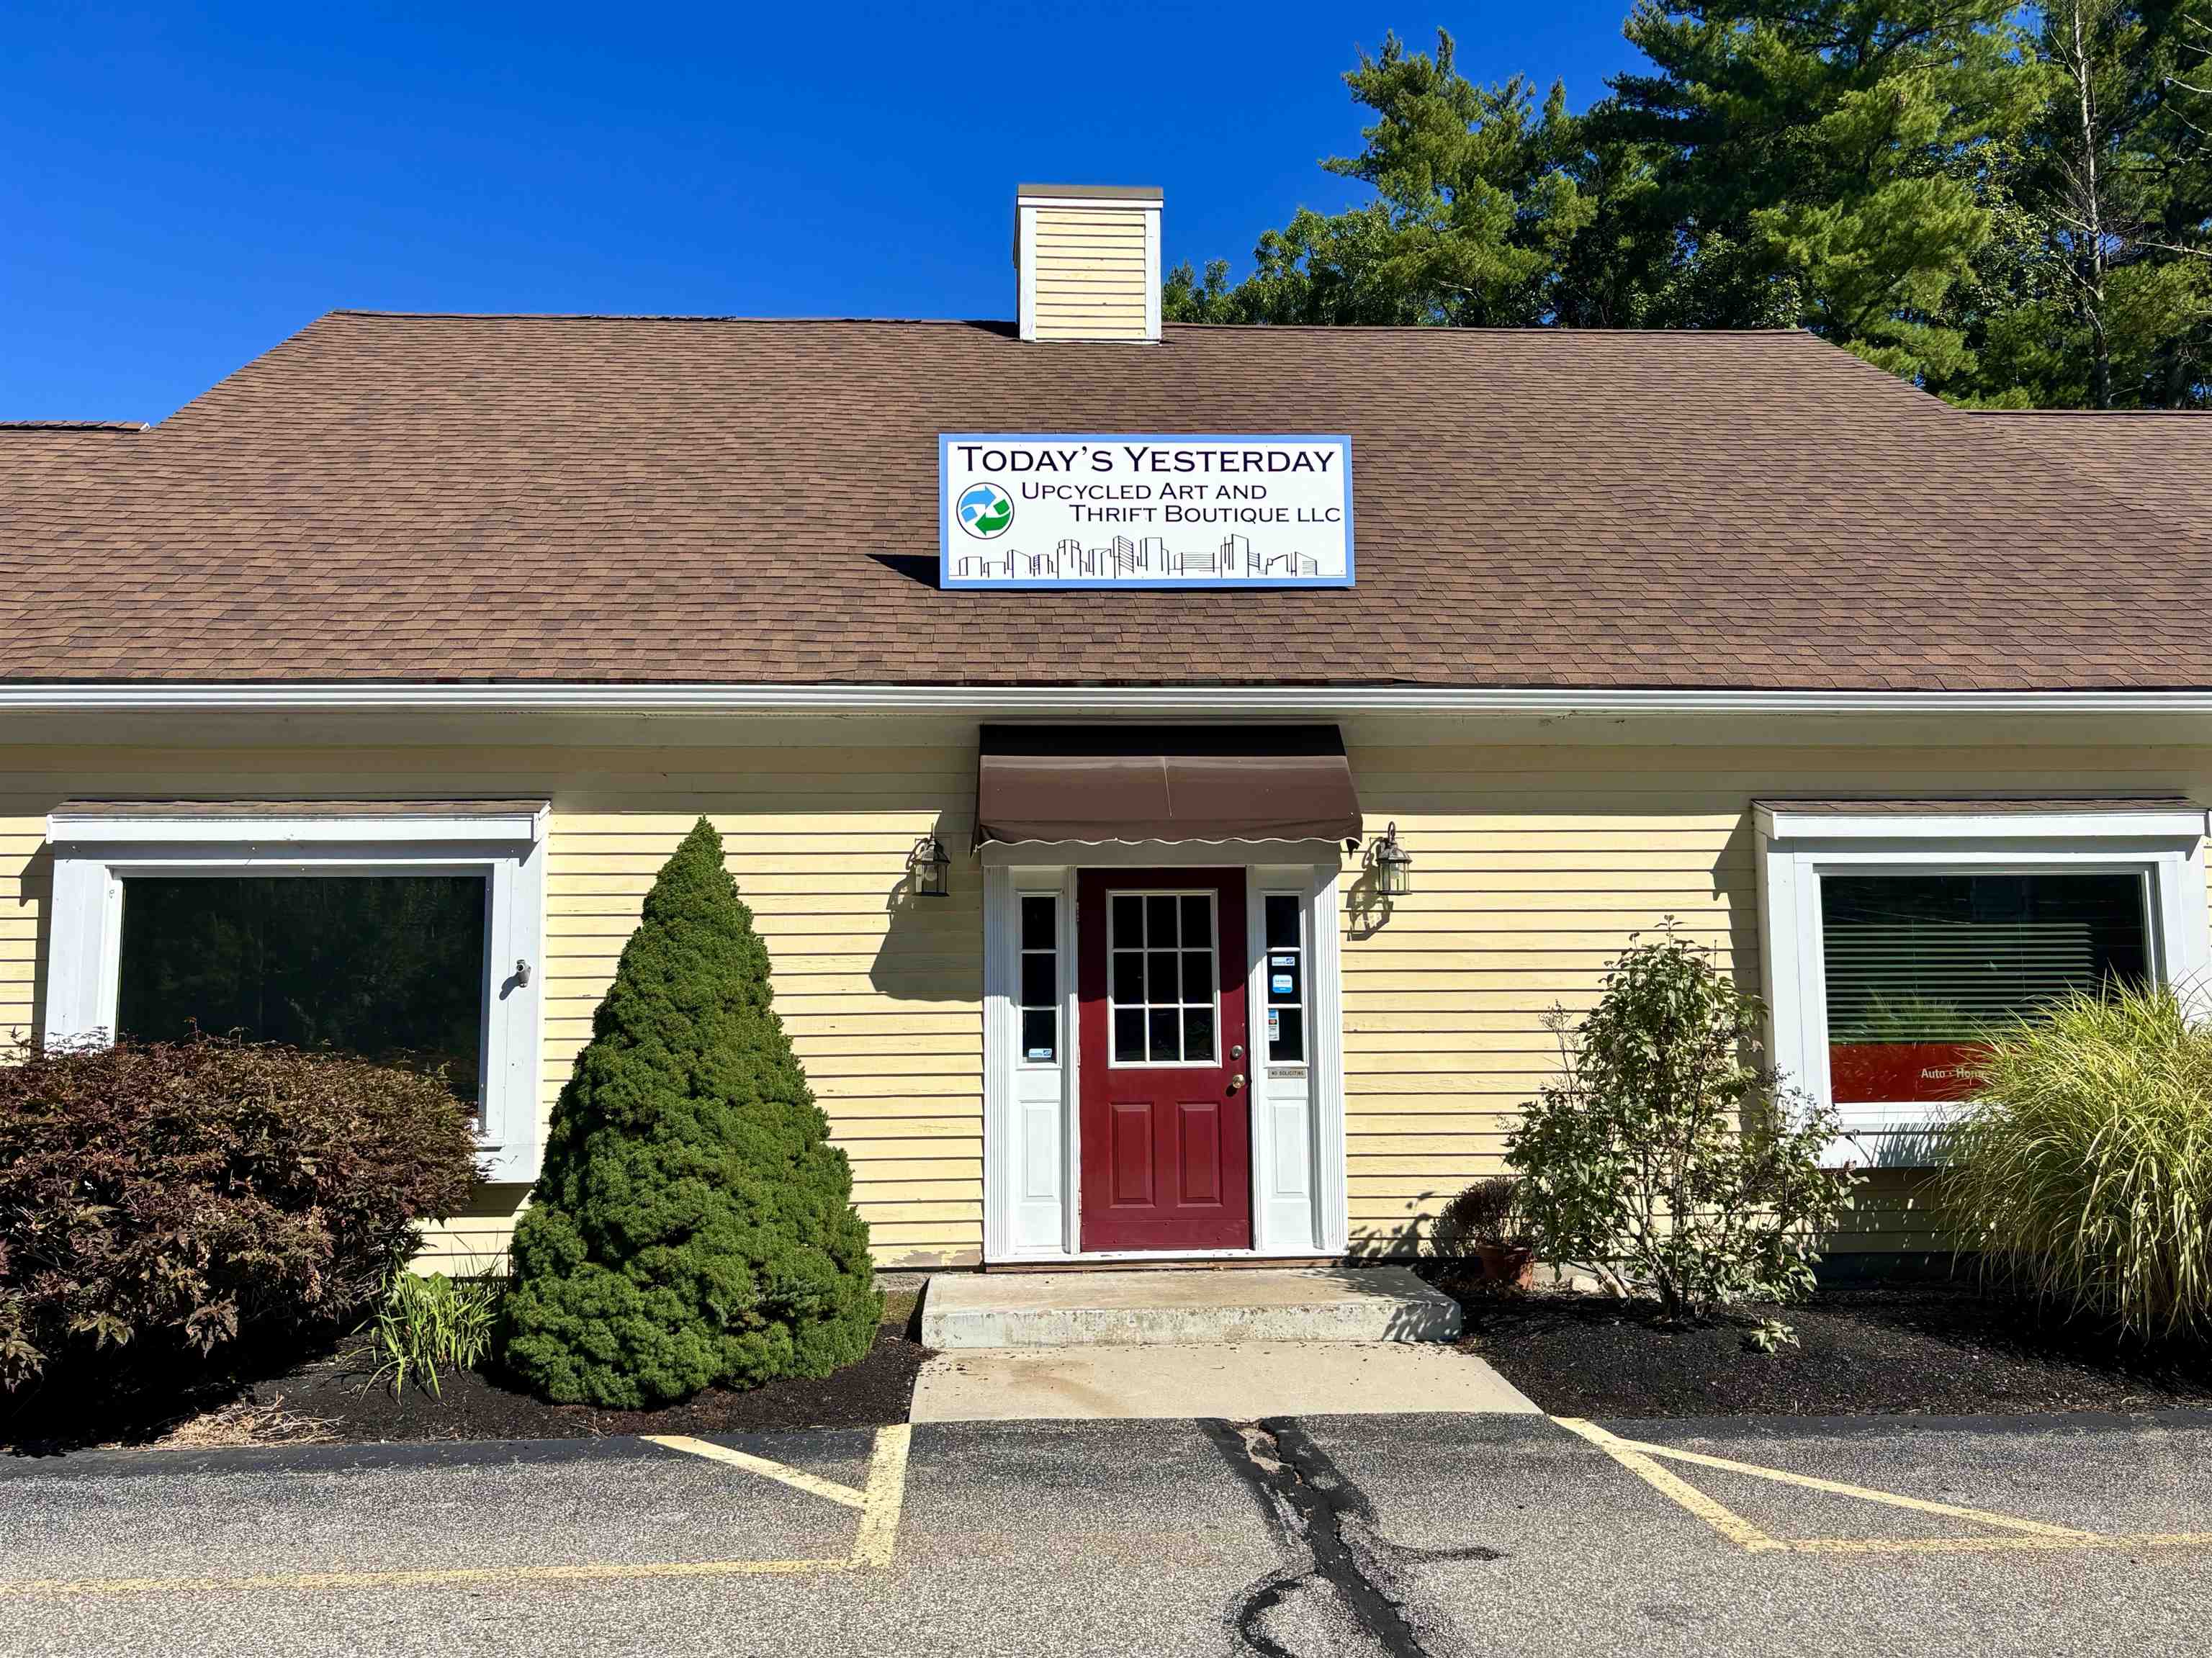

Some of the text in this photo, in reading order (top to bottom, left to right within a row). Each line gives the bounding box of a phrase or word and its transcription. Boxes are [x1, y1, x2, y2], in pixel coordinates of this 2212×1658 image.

[957, 445, 1336, 473] TODAY'S YESTERDAY
[1021, 482, 1267, 500] UPCYCLED ART AND
[1069, 503, 1341, 525] THRIFT BOUTIQUE LLC
[1920, 1068, 1946, 1079] Auto
